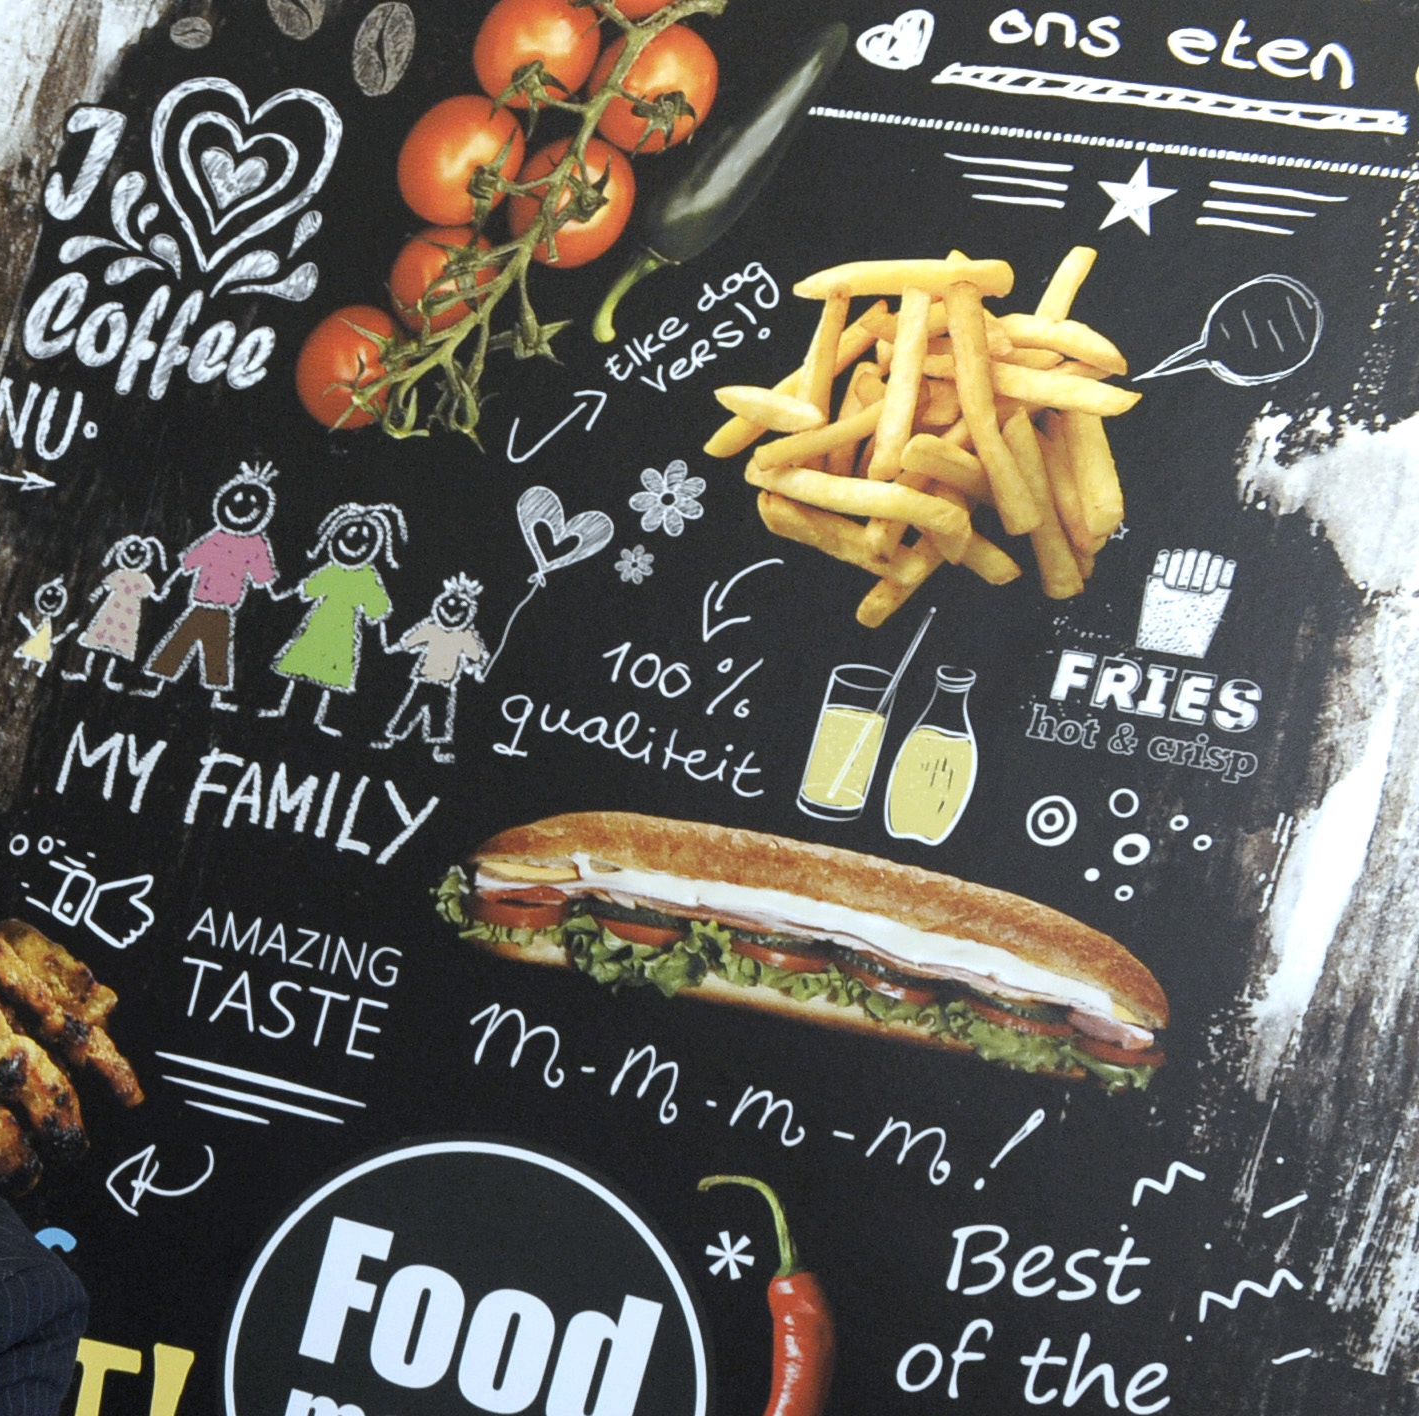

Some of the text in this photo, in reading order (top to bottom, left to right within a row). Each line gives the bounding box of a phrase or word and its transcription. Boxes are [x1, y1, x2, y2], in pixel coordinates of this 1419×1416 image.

[989, 8, 1355, 90] ons eten
[697, 262, 779, 309] dag
[23, 272, 276, 400] Coffee
[1050, 649, 1262, 733] FRIES
[493, 694, 764, 798] qualiteit
[1026, 703, 1258, 784] hot & crisp
[56, 721, 439, 865] MY FAMILY
[187, 907, 403, 988] AMAZING
[182, 956, 389, 1060] TASTE
[946, 1224, 1151, 1305] Best
[896, 1318, 1171, 1416] of the
